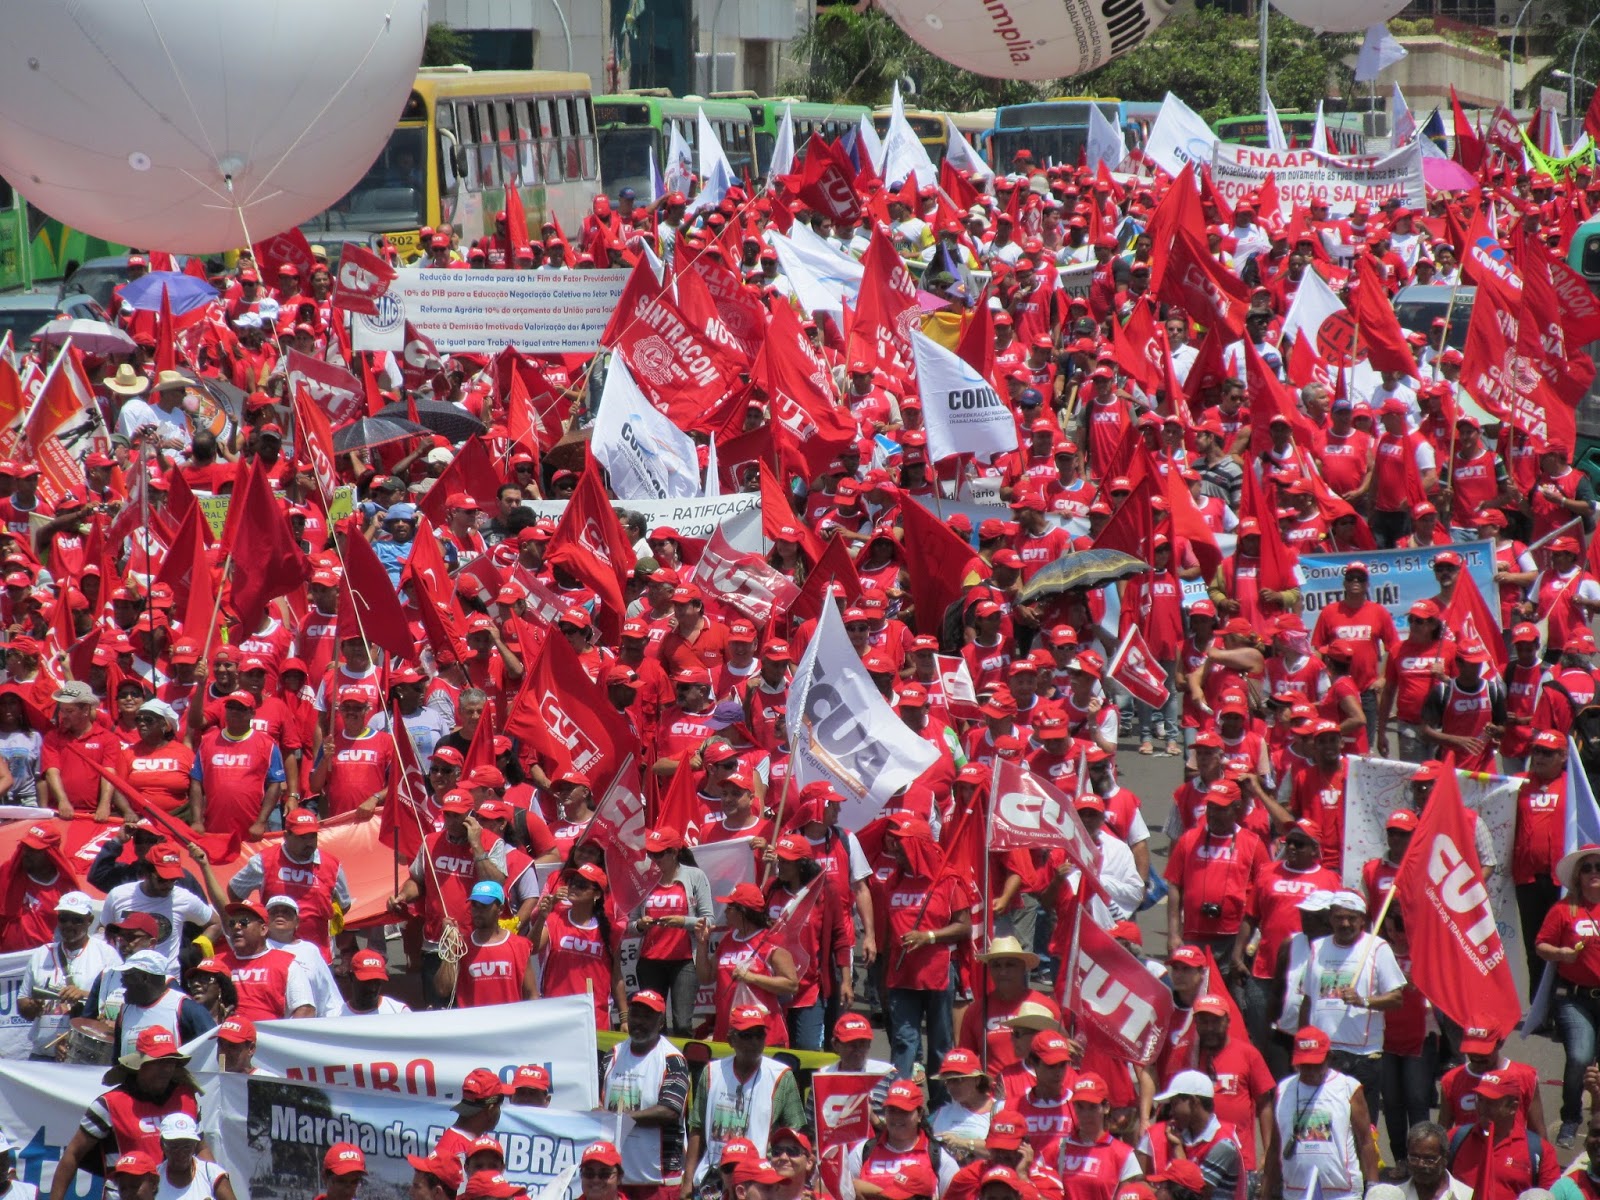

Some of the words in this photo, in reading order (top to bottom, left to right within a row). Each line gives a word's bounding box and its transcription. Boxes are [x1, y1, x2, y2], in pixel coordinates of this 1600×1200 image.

[1333, 181, 1409, 202] SALARIAL
[419, 273, 451, 282] Redução
[465, 273, 495, 282] Jornada
[537, 274, 551, 282] Fim
[583, 273, 626, 281] Previdenciário
[473, 290, 509, 299] Educação
[509, 290, 551, 299] Negociação
[552, 290, 581, 298] Coletiva
[592, 290, 608, 298] Setor
[420, 305, 453, 313] Reforma
[454, 306, 483, 315] Agrária
[512, 307, 550, 315] orçamento
[563, 306, 584, 314] União
[413, 321, 441, 330] ombate
[449, 321, 484, 330] Demissão
[485, 322, 524, 331] Imotivada
[524, 322, 563, 332] Valorização
[446, 338, 466, 348] igual
[467, 340, 485, 349] para
[487, 338, 521, 348] Trabalho
[522, 338, 541, 348] igual
[542, 339, 559, 347] entre
[561, 339, 589, 347] Homens
[671, 363, 689, 381] CUT
[1325, 445, 1353, 455] CUT
[1026, 464, 1055, 476] CUT
[1456, 466, 1485, 478] CUT
[1055, 499, 1089, 512] CUT
[1288, 528, 1316, 540] CUT
[1022, 548, 1047, 560] CUT
[1301, 556, 1390, 580] Conveão
[1395, 556, 1422, 571] 151
[1376, 582, 1399, 606] JÁ!
[1337, 626, 1369, 639] CUT
[1514, 626, 1529, 634] CUT
[238, 639, 272, 652] CUT
[982, 655, 1010, 670] CUT
[1402, 657, 1437, 669] CUT
[1455, 698, 1491, 711] CUT
[672, 723, 706, 735] CUT
[1316, 722, 1336, 730] CUT
[212, 754, 248, 765] CUT
[338, 750, 374, 762] CUT
[132, 758, 174, 771] CUT
[579, 752, 605, 775] BRASIL
[445, 795, 461, 803] CUT
[1198, 846, 1232, 860] CUT
[436, 857, 472, 872] CUT
[278, 867, 316, 885] CUT
[1273, 881, 1315, 893] CUT
[1427, 833, 1498, 947] CUT
[892, 893, 925, 905] CUT
[560, 935, 600, 953] CUT
[1448, 919, 1490, 976] TRABALHADORES
[363, 958, 380, 966] CUT
[720, 952, 752, 966] CUT
[231, 968, 265, 982] CUT
[469, 962, 510, 977] CUT
[221, 1021, 240, 1031] CUT
[154, 1034, 171, 1042] CUT
[1468, 1028, 1487, 1037] CUT
[1048, 1039, 1066, 1047] CUT
[1299, 1040, 1318, 1048] CUT
[521, 1068, 540, 1077] CUT
[1481, 1074, 1500, 1083] CUT
[891, 1087, 910, 1095] CUT
[1075, 1081, 1094, 1089] CUT
[994, 1123, 1014, 1132] CUT
[1026, 1115, 1068, 1132] CUT
[271, 1104, 377, 1154] Marcha
[384, 1119, 420, 1160] da
[476, 1138, 494, 1146] CUT
[726, 1143, 746, 1152] CUT
[340, 1151, 358, 1159] CUT
